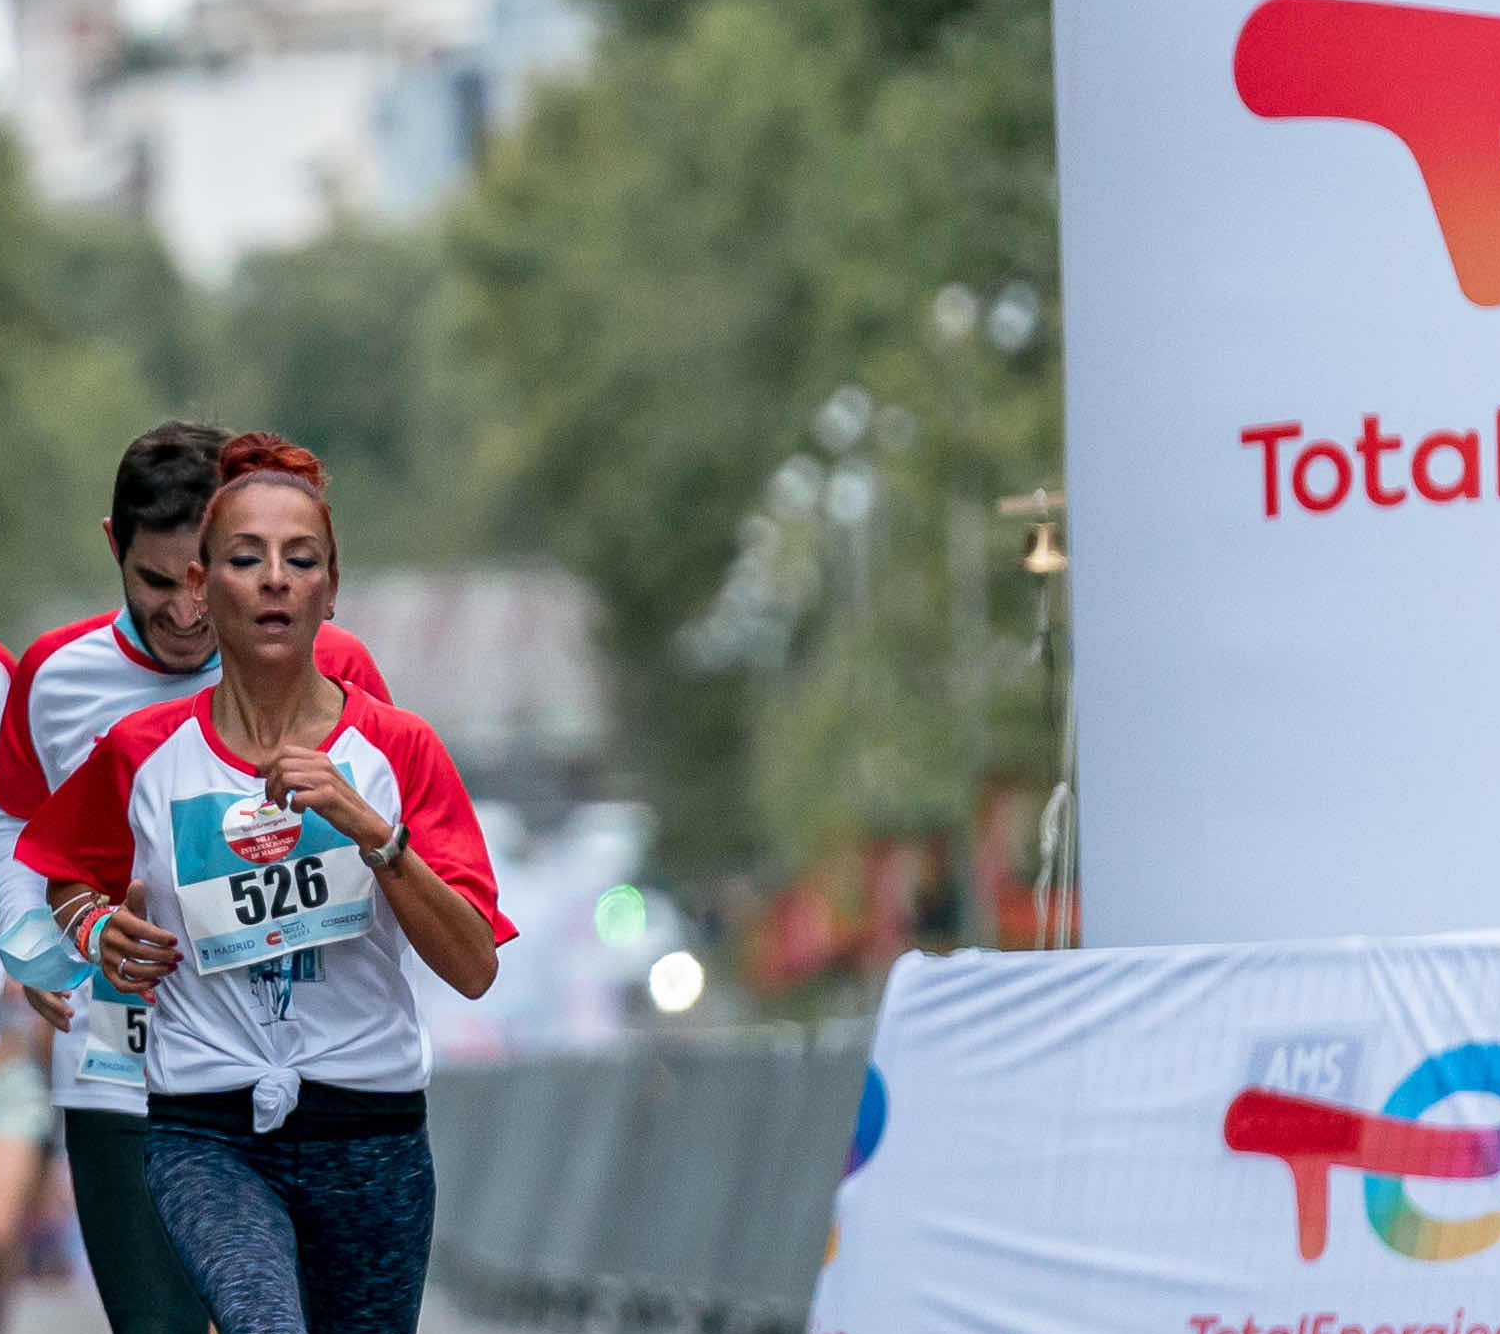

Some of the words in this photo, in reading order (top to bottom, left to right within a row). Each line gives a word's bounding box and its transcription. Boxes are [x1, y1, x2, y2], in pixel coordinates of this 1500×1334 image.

[230, 857, 327, 925] 526
[214, 939, 256, 956] MADRID
[1264, 1043, 1347, 1093] AMS
